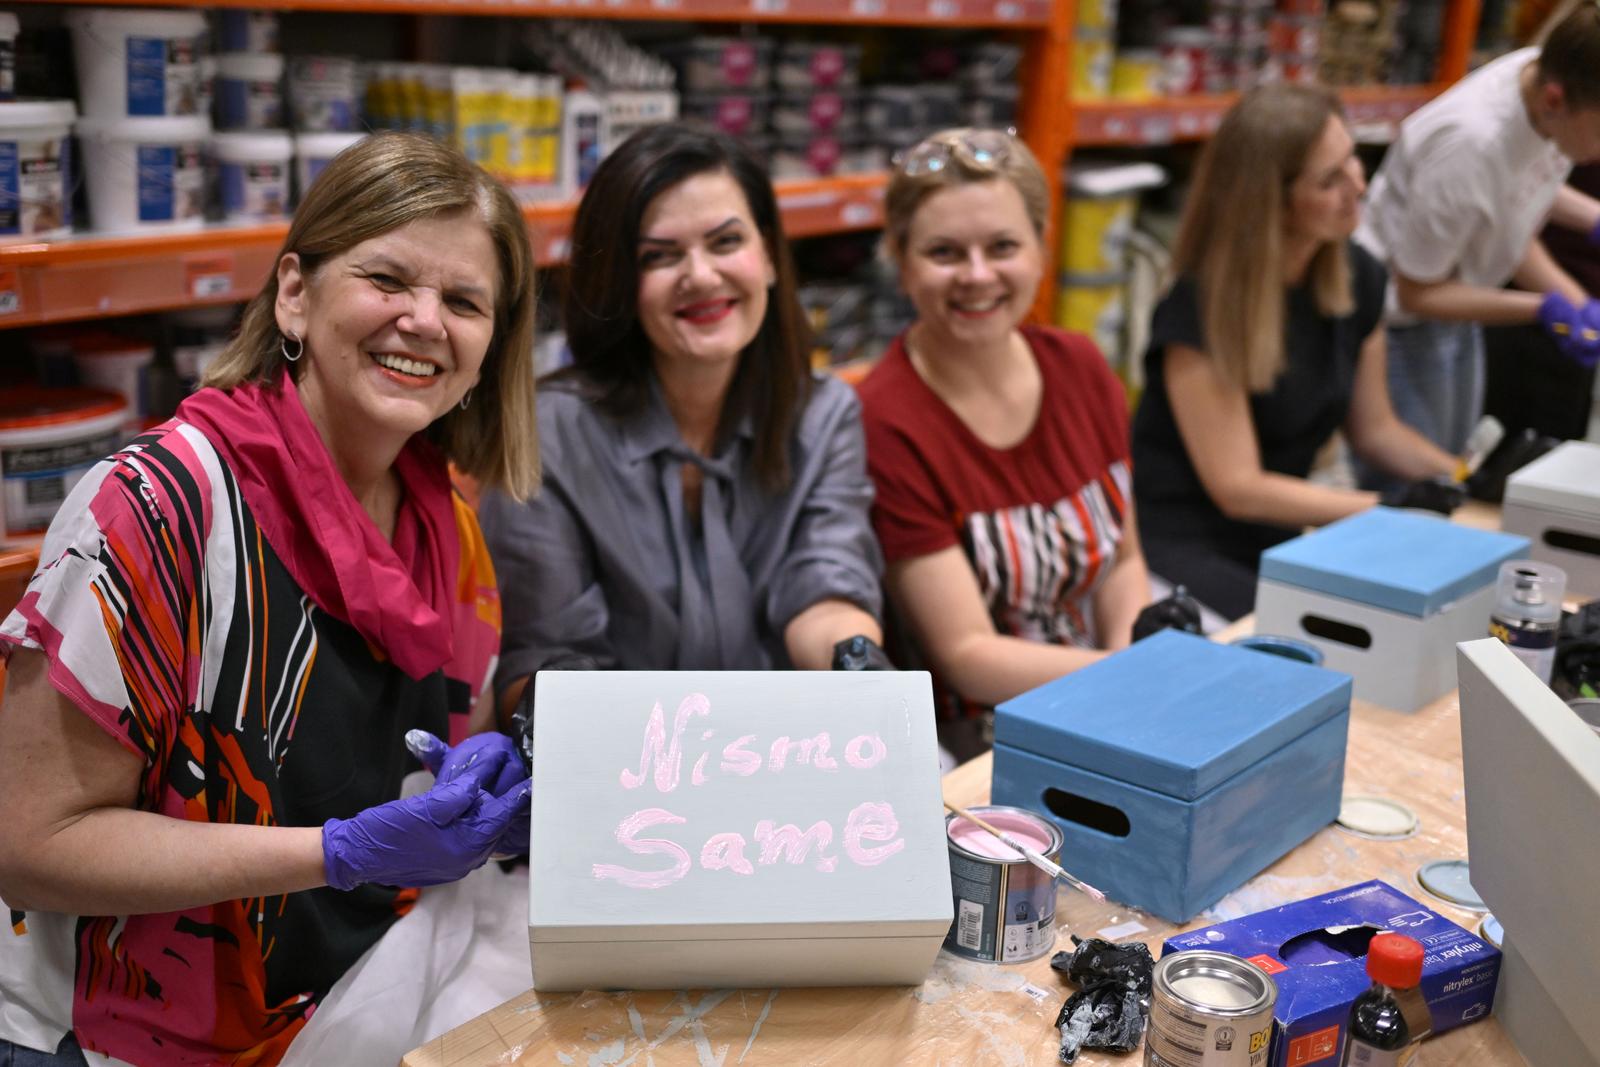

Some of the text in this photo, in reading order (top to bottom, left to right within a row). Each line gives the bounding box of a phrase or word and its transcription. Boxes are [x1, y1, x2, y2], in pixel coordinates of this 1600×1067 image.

[619, 692, 887, 793] Nismo
[592, 801, 905, 889] Same
[1440, 942, 1484, 960] nitrylex
[1443, 976, 1474, 993] nitrylex
[1249, 1024, 1272, 1054] BO
[1296, 1046, 1303, 1060] L
